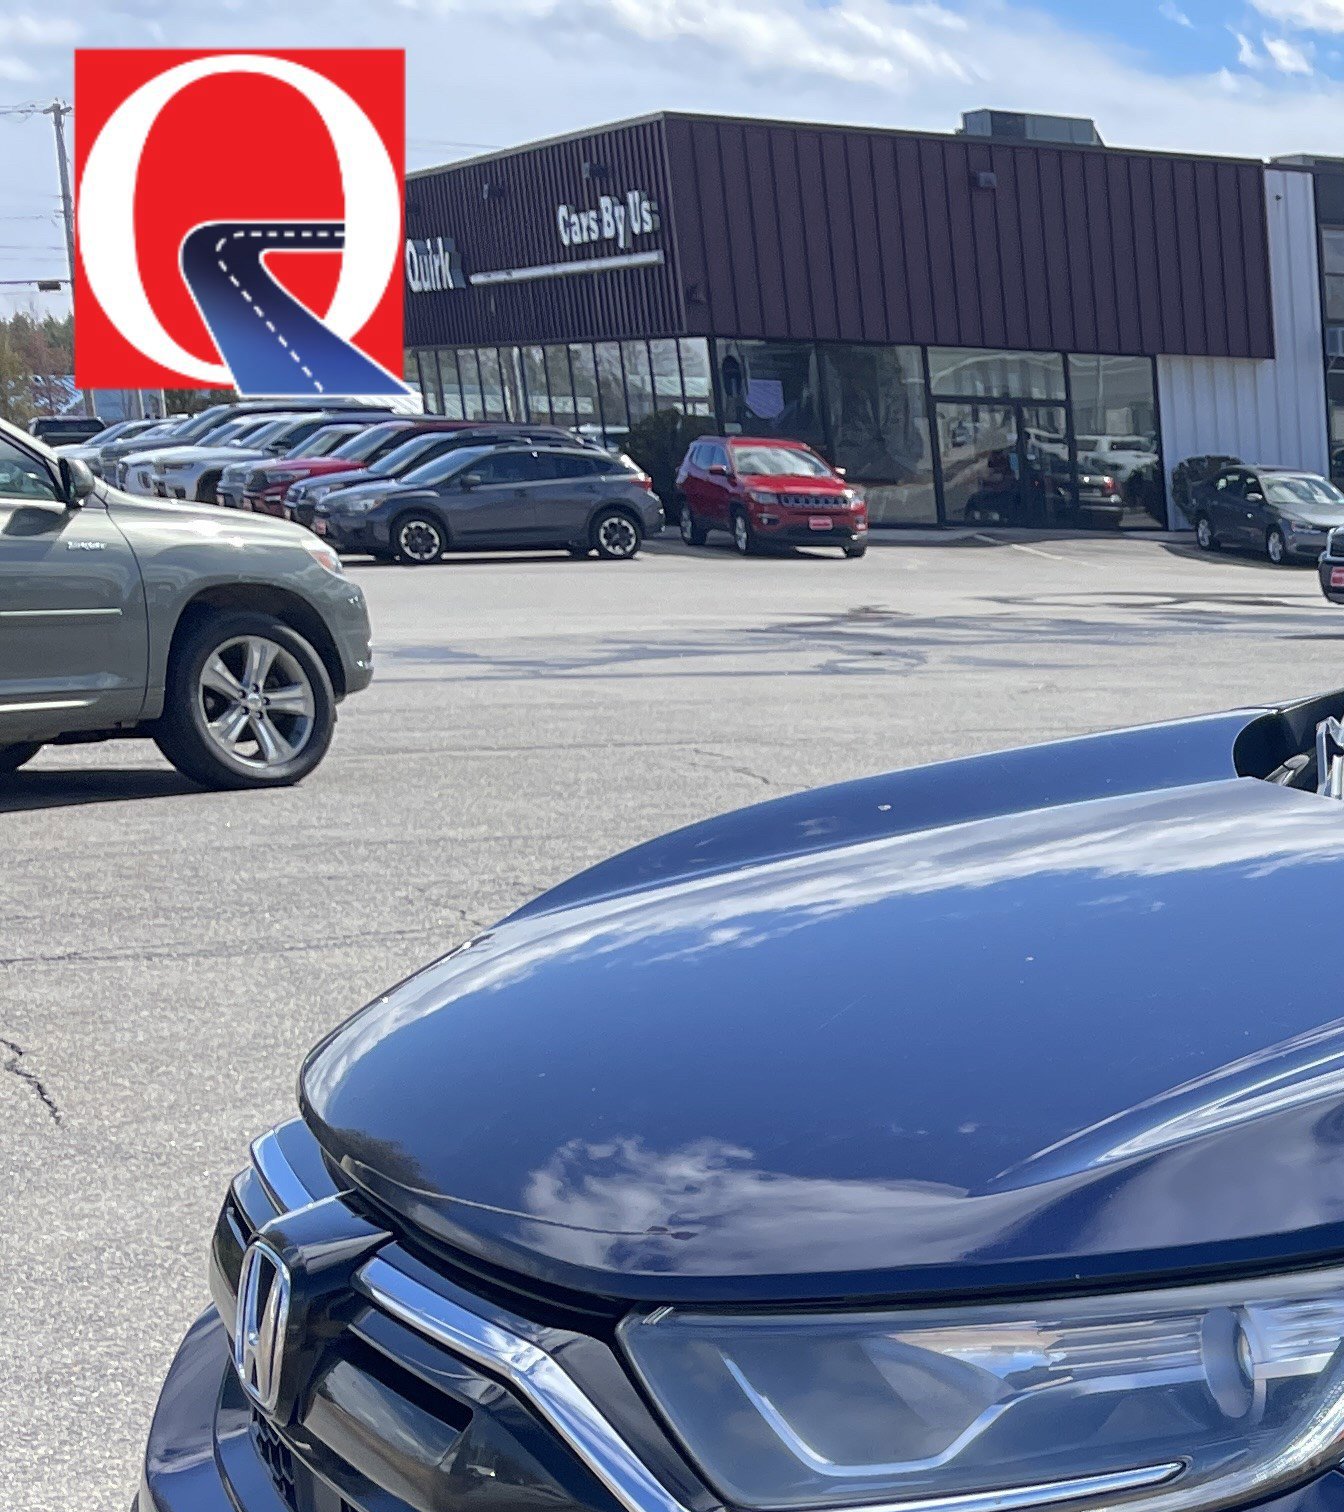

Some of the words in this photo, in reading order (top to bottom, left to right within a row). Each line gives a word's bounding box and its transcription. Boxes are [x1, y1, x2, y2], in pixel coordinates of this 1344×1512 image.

[557, 203, 600, 247] Cars
[600, 195, 627, 249] By
[626, 189, 652, 235] Us
[405, 236, 455, 293] Quirk
